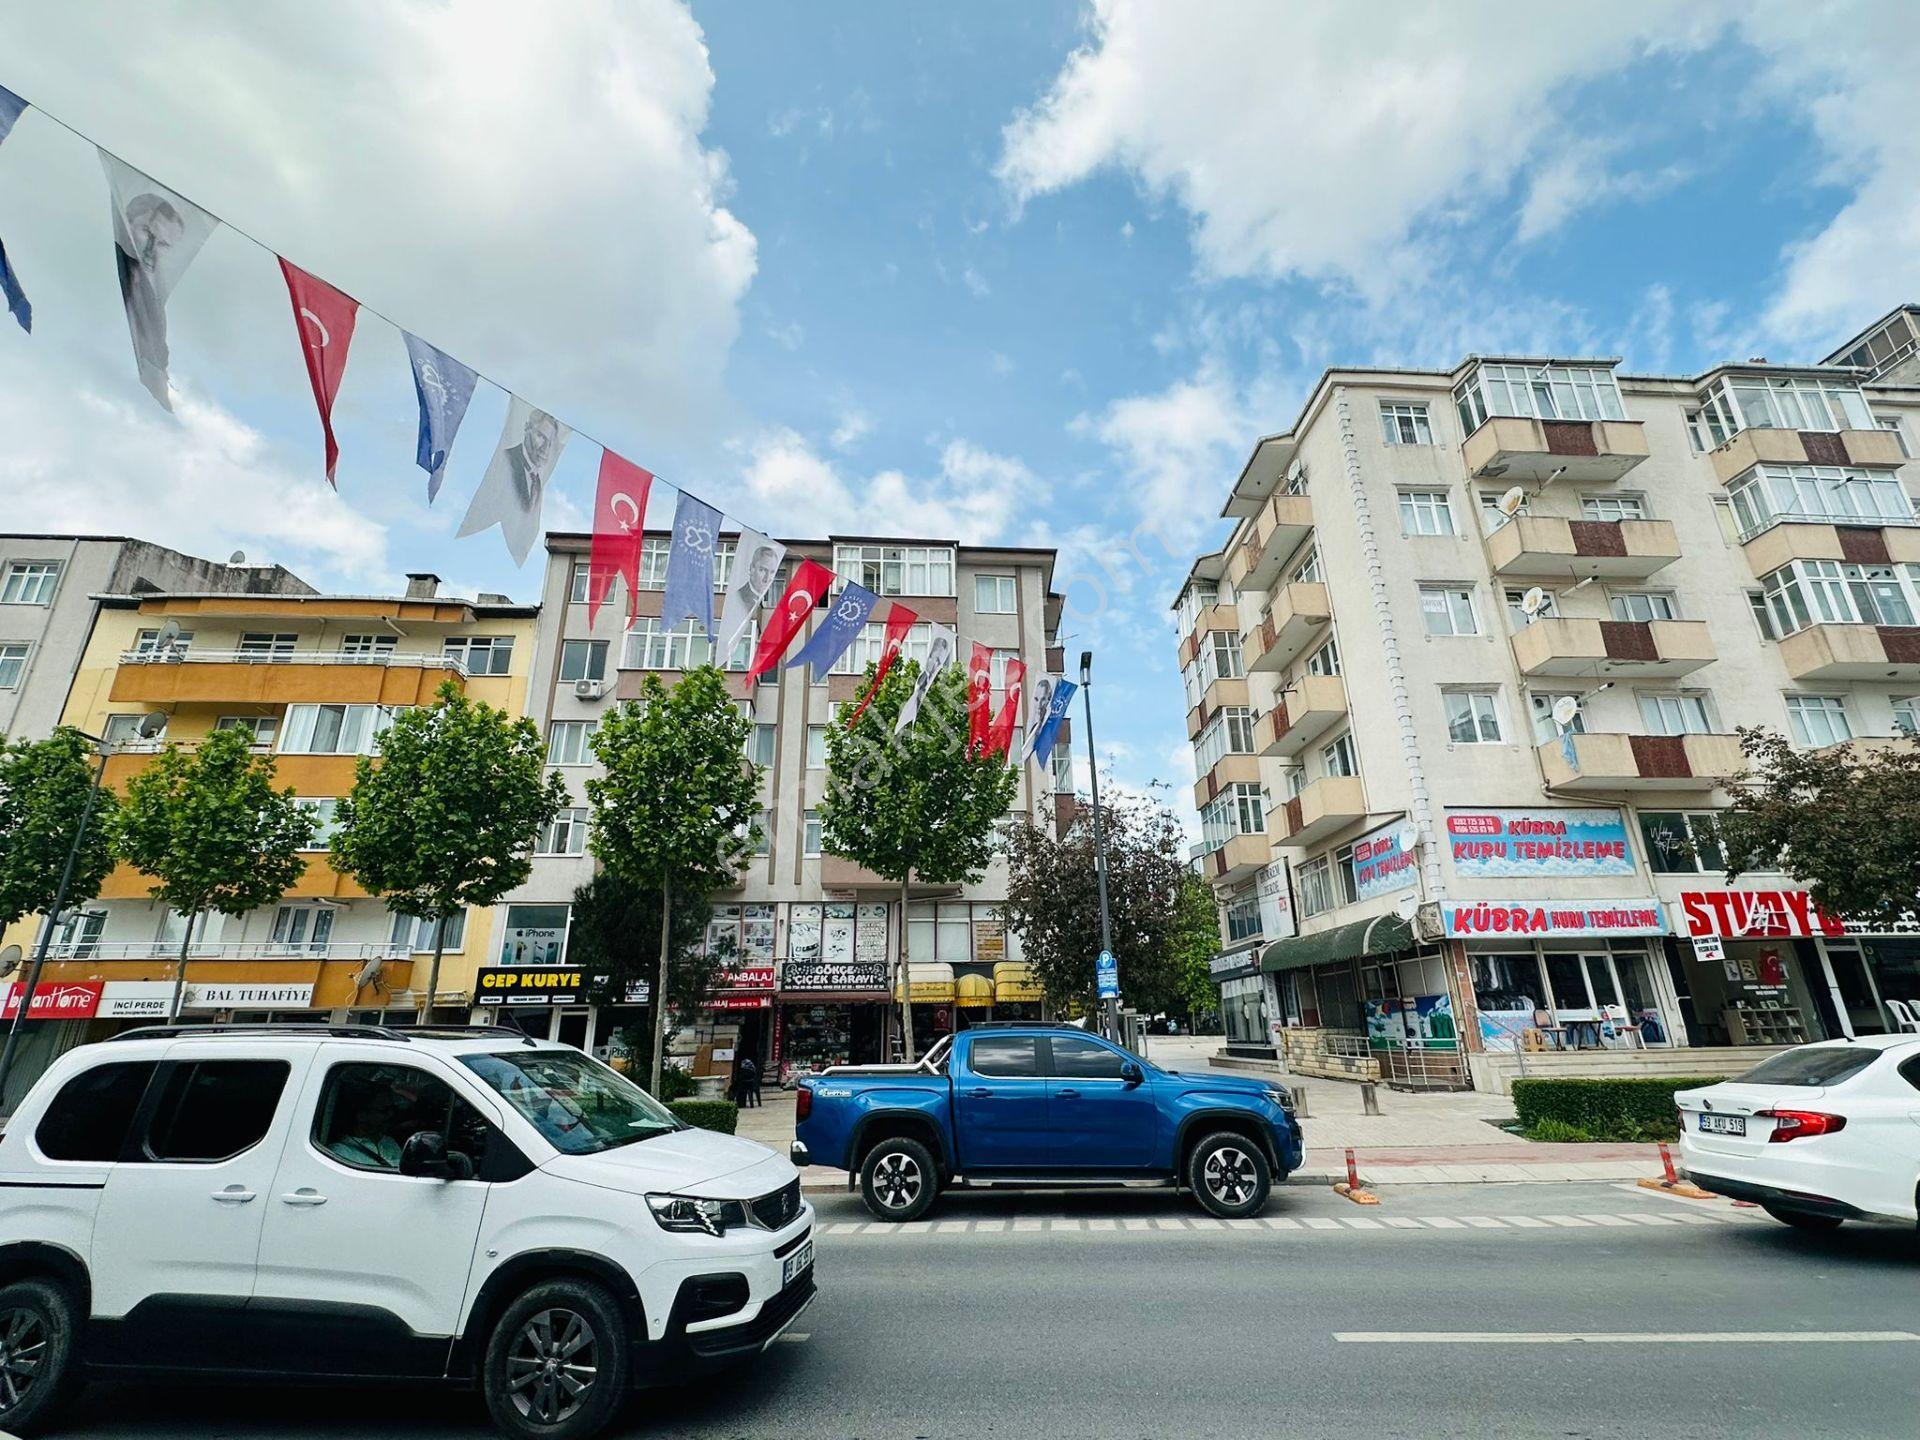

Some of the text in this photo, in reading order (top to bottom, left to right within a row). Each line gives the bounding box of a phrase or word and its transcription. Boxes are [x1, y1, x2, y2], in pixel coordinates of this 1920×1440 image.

[1508, 817, 1567, 836] KÜBRA
[1454, 836, 1626, 859] KURU TEMİZLEME
[1453, 903, 1660, 934] KÜBRA KURU TEMİZLEME
[525, 929, 555, 937] iPhone
[727, 972, 773, 982] AMBALAJ
[815, 964, 855, 976] GÖKÇE
[482, 973, 517, 988] CEP
[521, 973, 581, 987] KURYE
[831, 974, 875, 984] SARAYI
[206, 987, 311, 1001] BAL TUHAFİYE
[135, 1001, 165, 1009] PERDE
[1714, 1118, 1727, 1129] AKU
[1729, 1119, 1743, 1132] 519
